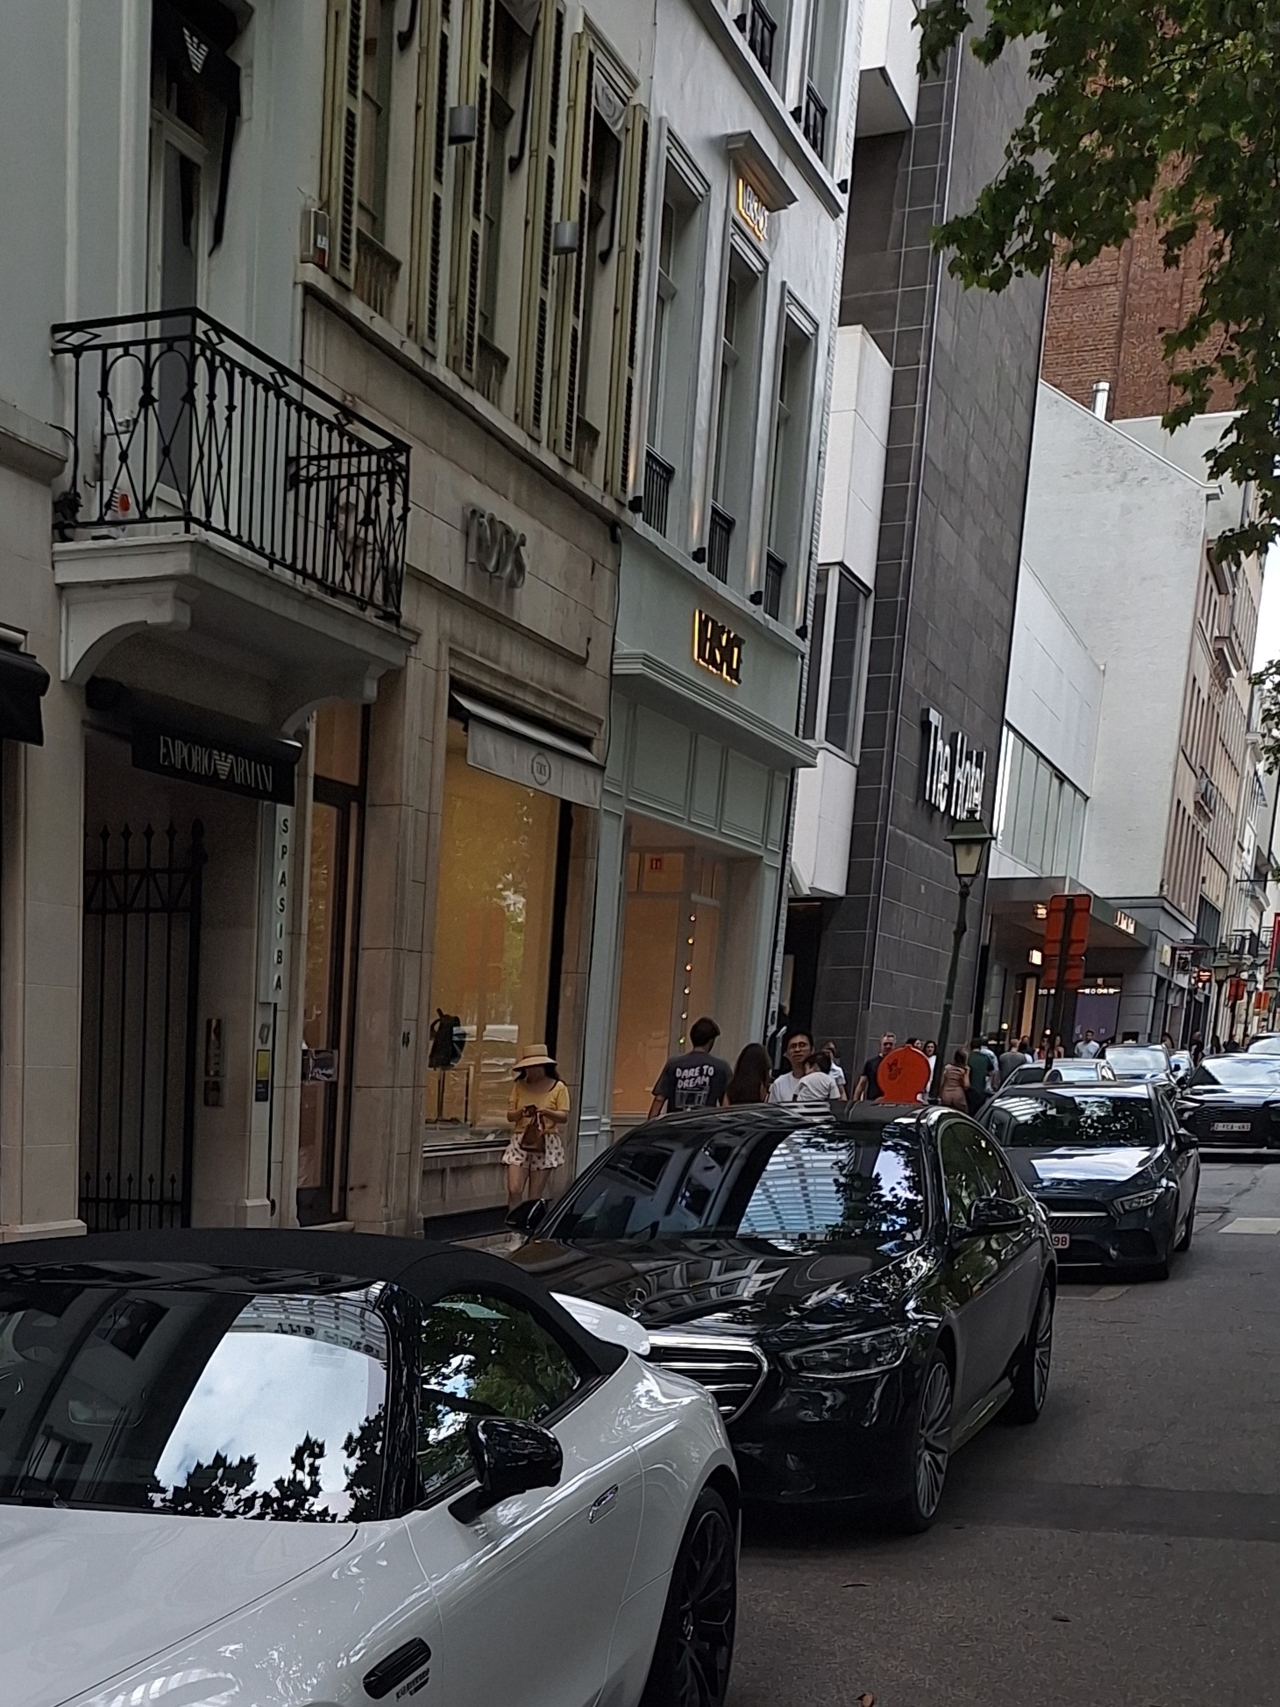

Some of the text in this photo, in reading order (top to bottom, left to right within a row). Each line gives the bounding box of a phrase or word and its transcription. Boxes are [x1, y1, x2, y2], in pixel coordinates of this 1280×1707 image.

[160, 735, 273, 793] EMPORIO ARMANI
[922, 706, 951, 813] The
[274, 817, 289, 992] SPASIBA
[675, 1064, 715, 1079] DARE TO
[677, 1075, 710, 1089] DREAM
